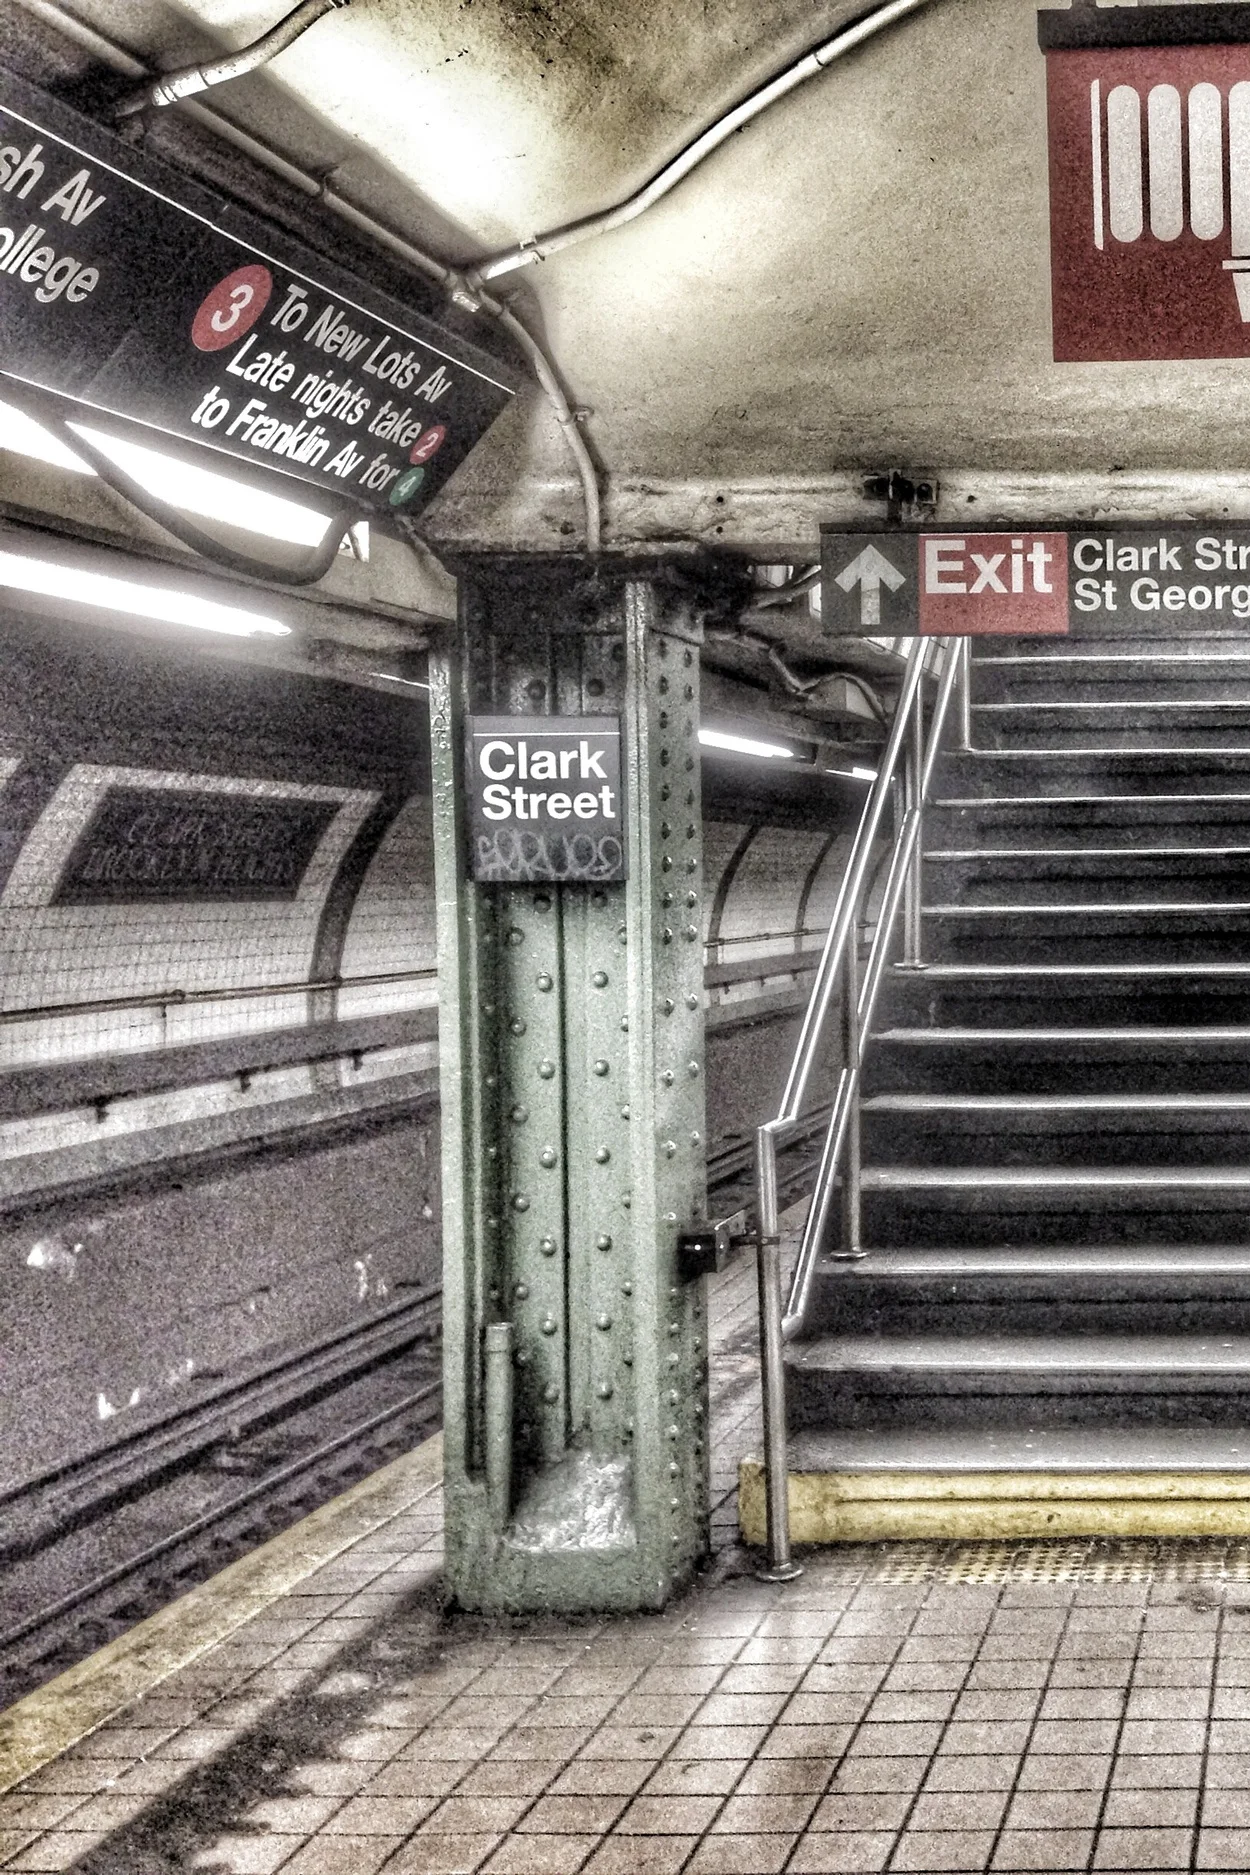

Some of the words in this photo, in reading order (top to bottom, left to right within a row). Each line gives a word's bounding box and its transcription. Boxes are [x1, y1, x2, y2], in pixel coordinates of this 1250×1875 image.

[0, 142, 45, 200] sh
[40, 169, 107, 226] Av
[211, 284, 254, 332] 3
[270, 284, 308, 332] To
[303, 305, 371, 362] New
[362, 335, 421, 389] Lots
[413, 365, 452, 403] Av
[225, 333, 295, 392] Late
[290, 369, 371, 425] nights
[368, 400, 422, 448] take
[416, 432, 439, 457] 2
[191, 385, 230, 429] to
[225, 399, 330, 467] Franklin
[323, 440, 365, 478] Av
[358, 453, 400, 491] for
[398, 476, 416, 497] 4
[924, 539, 1054, 594] Exit
[1073, 538, 1183, 572] Clark
[1073, 577, 1118, 612] St
[479, 741, 608, 780] Clark
[482, 784, 616, 820] Street
